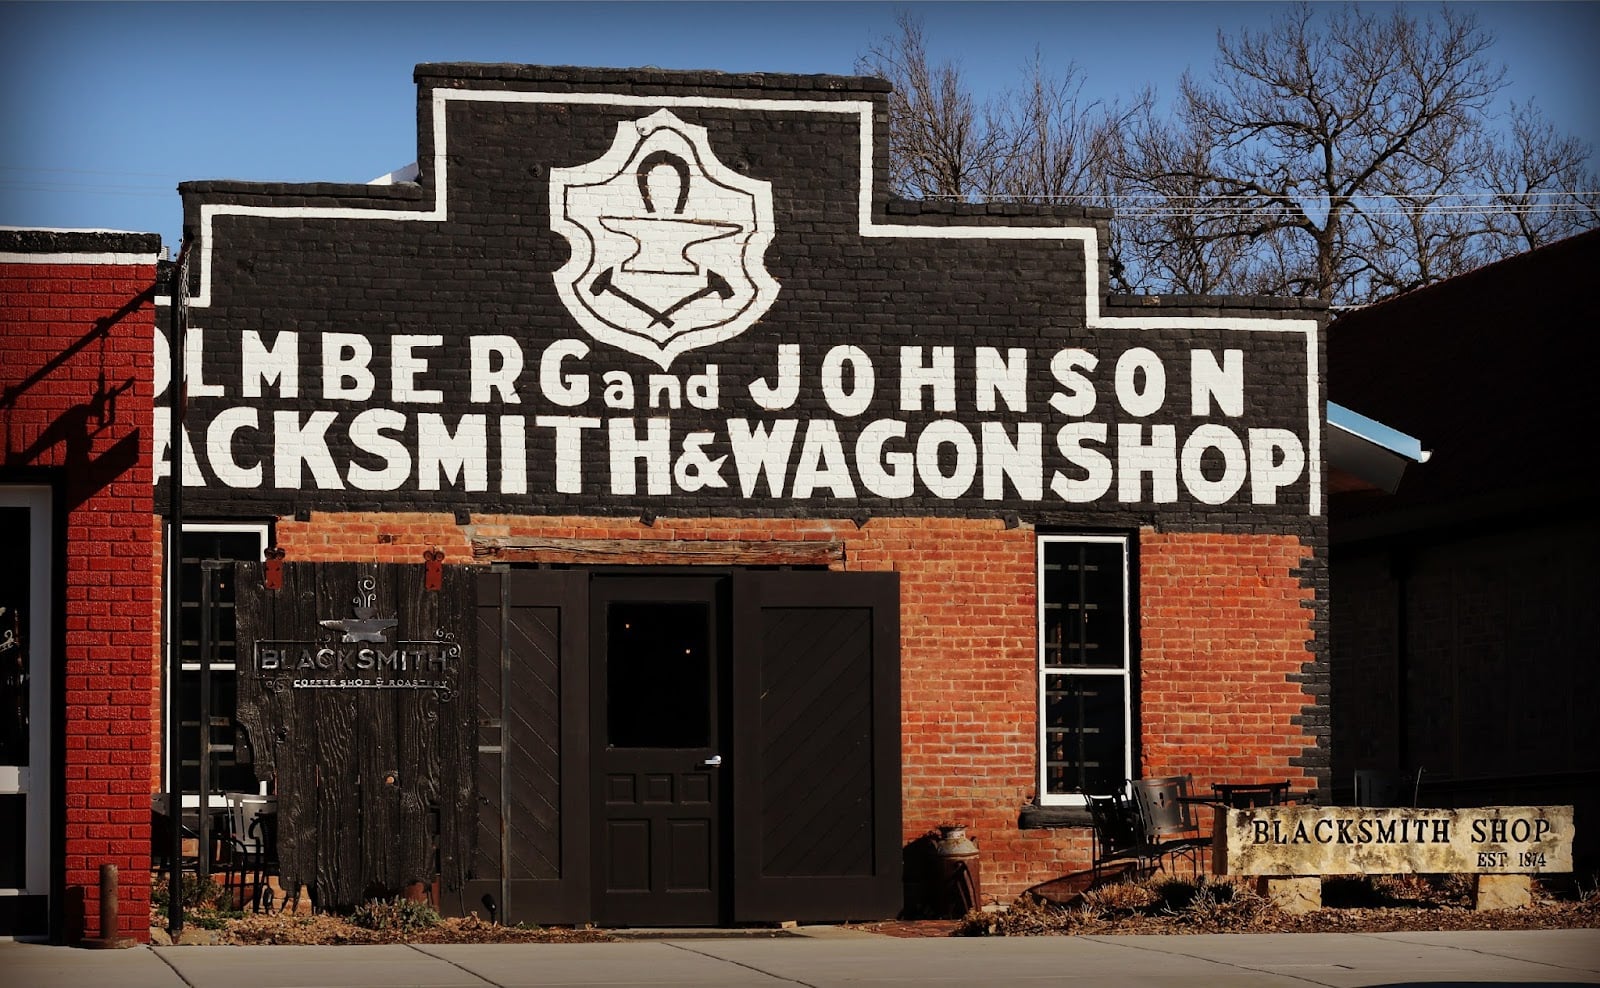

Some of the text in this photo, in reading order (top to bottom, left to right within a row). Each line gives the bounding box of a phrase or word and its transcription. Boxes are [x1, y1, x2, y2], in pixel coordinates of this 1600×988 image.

[602, 364, 719, 410] and
[748, 344, 1244, 417] JOHNSON
[262, 648, 447, 671] BLACKSMITH
[293, 677, 447, 688] COFFEE SHOP & ROASTERY
[1253, 818, 1550, 845] BLACKSMITH SHOP
[1519, 852, 1546, 867] 1874
